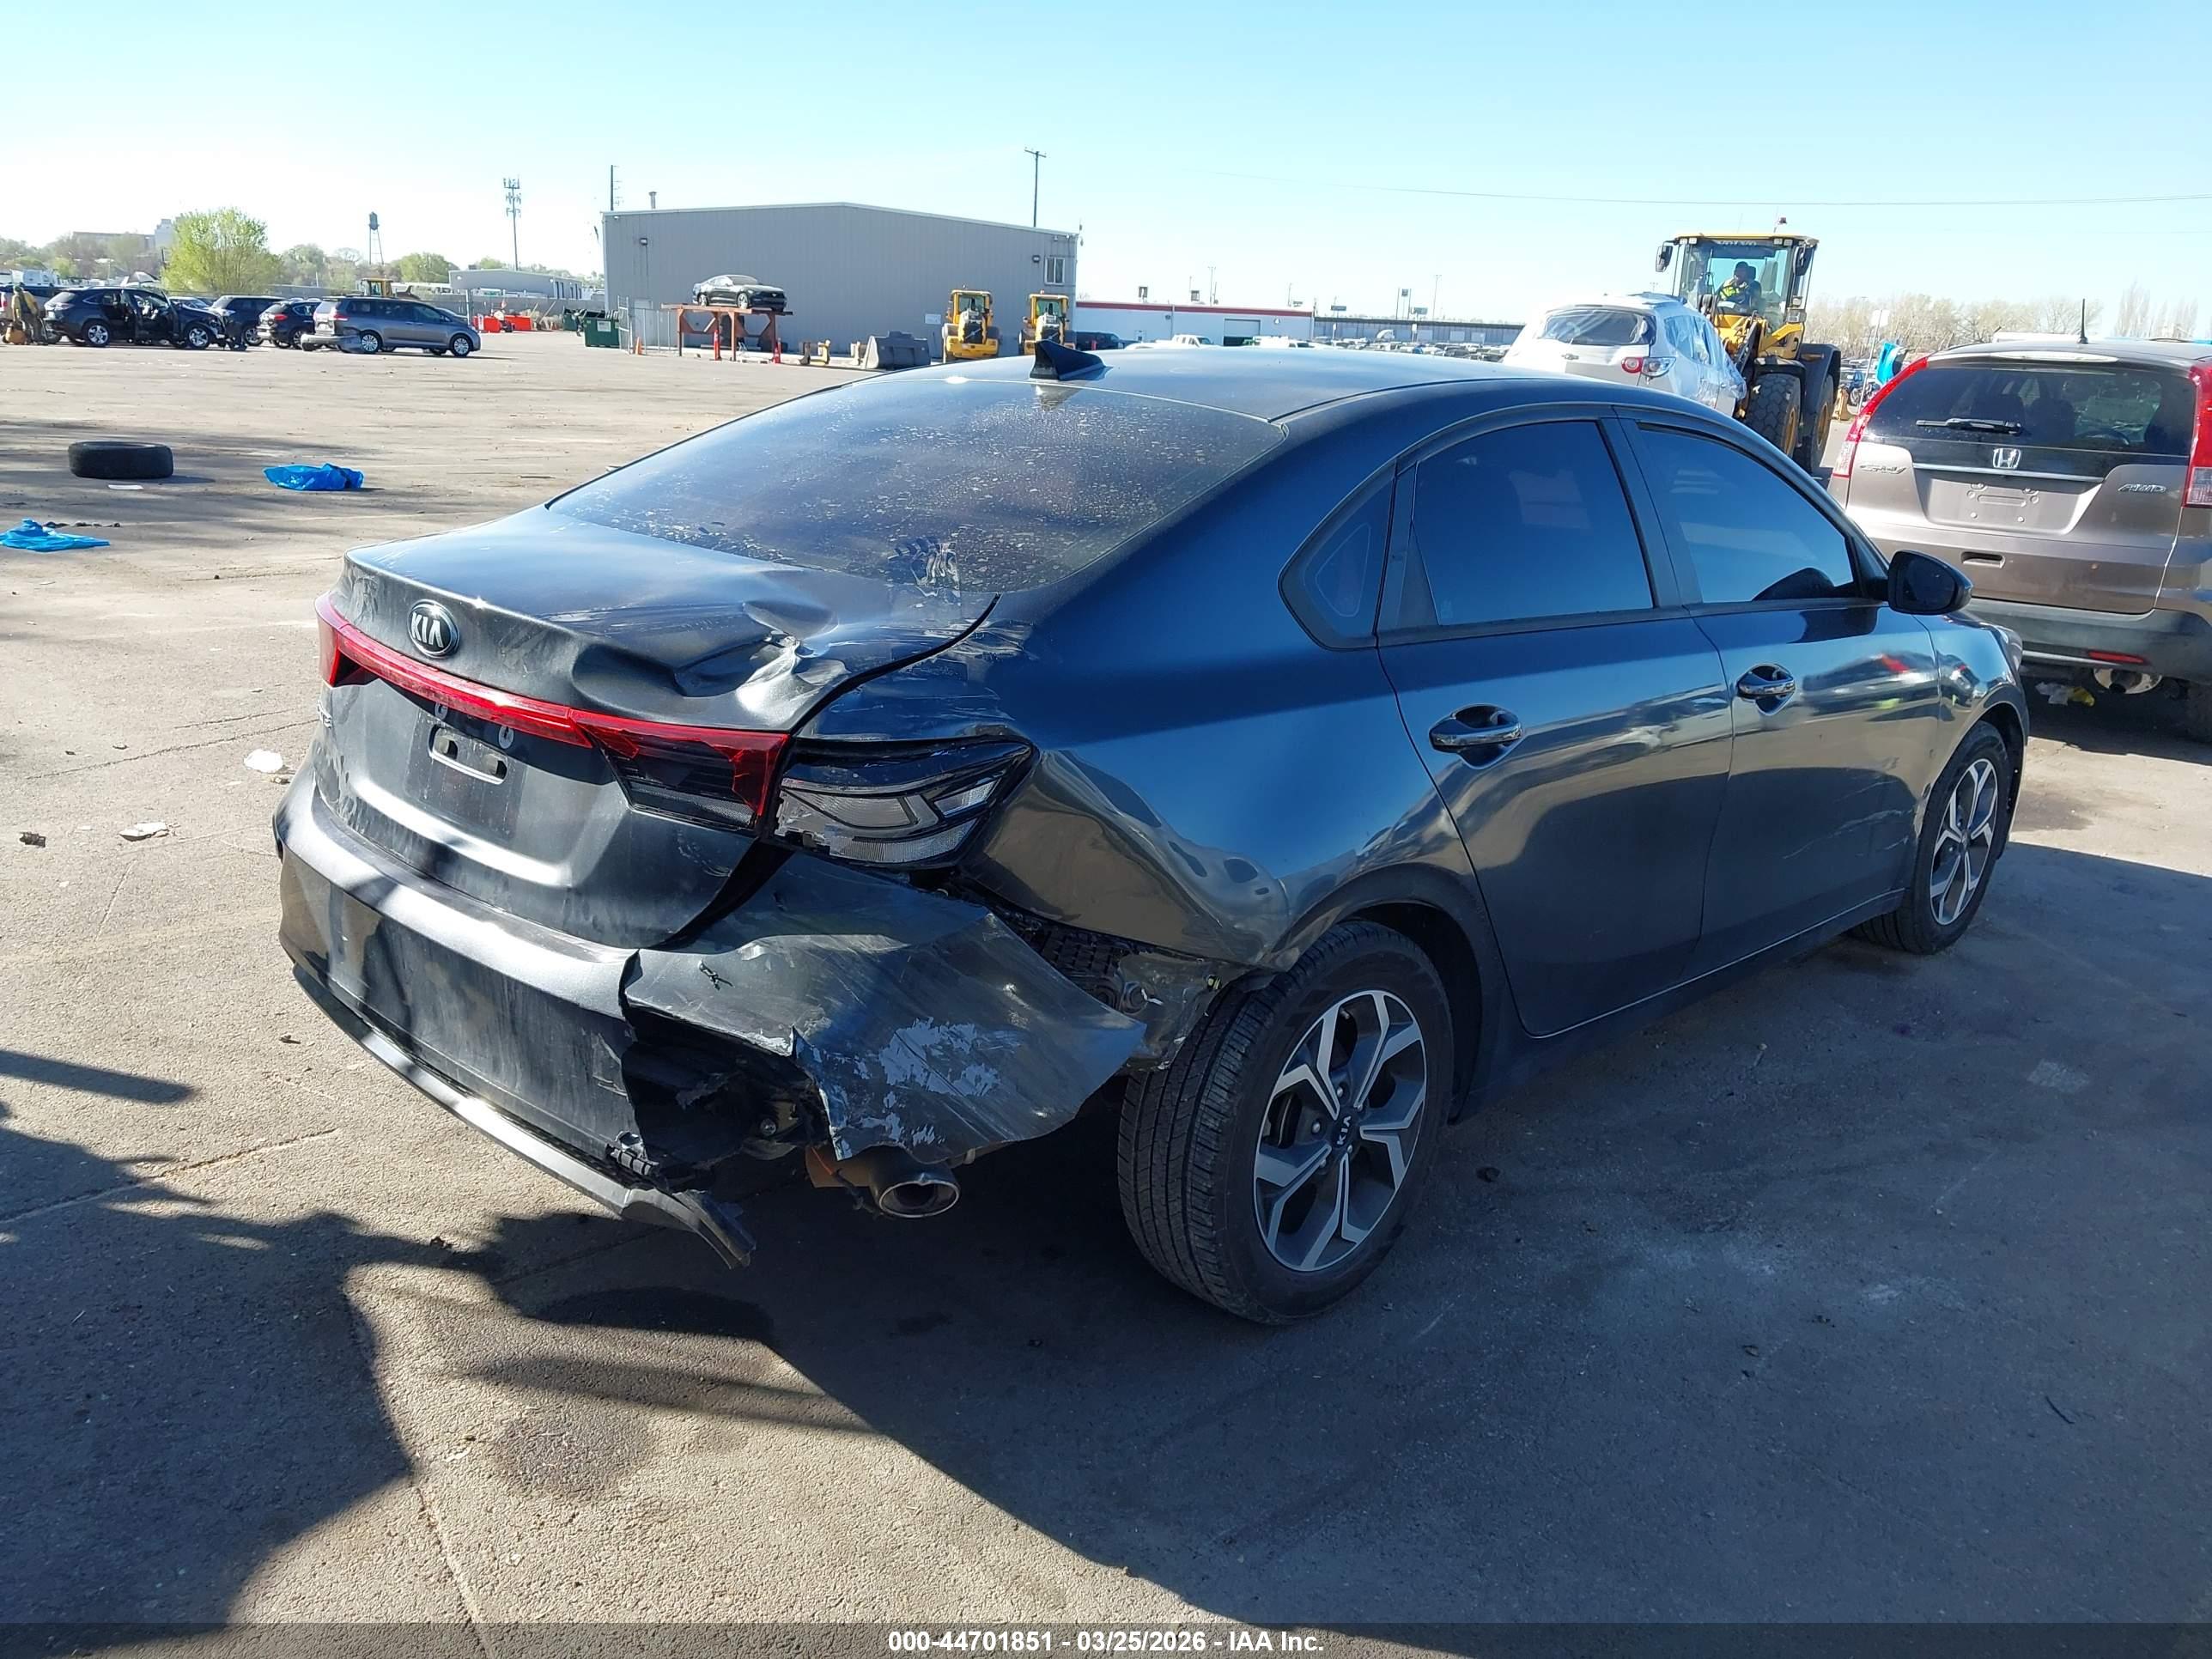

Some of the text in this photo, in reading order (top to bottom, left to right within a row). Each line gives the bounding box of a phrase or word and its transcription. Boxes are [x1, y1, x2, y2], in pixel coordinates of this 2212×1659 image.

[2118, 483, 2166, 493] AWD
[411, 611, 444, 648] KIA
[1336, 1115, 1352, 1145] KIA
